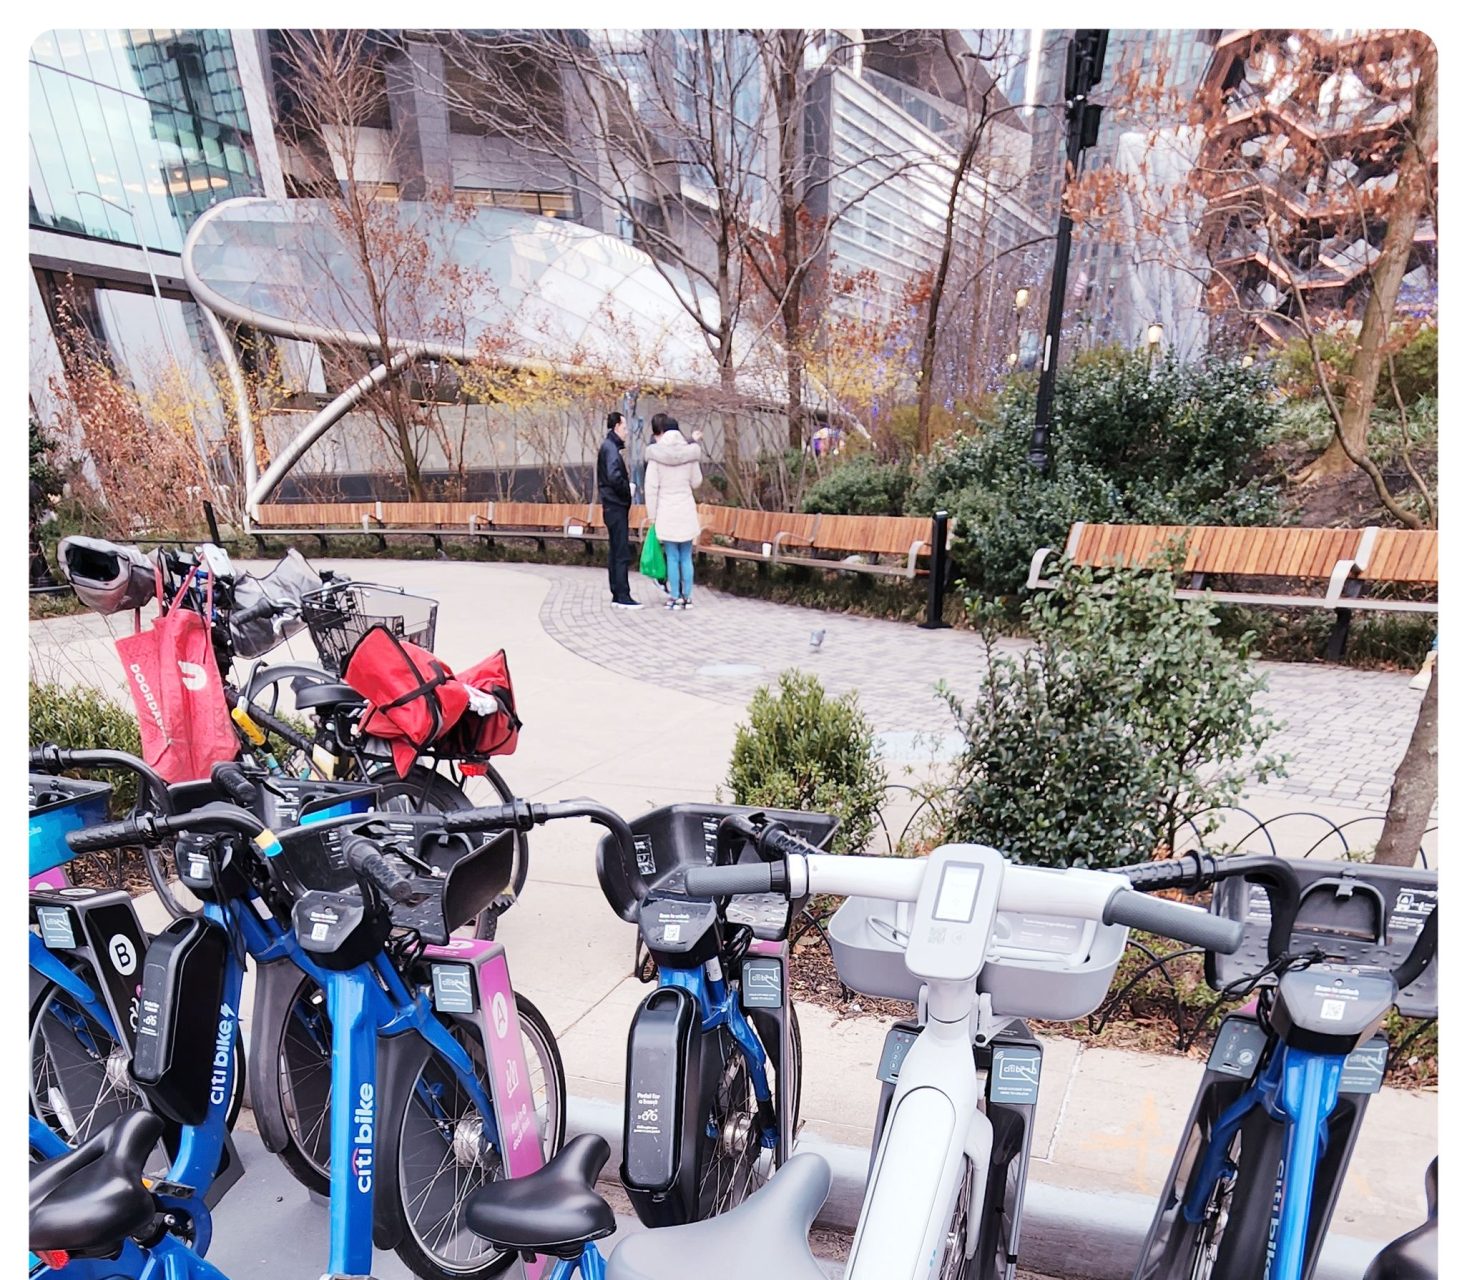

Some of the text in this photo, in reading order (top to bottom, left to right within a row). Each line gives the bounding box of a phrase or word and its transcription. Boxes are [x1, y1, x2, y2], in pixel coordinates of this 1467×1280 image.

[130, 663, 168, 738] DOORDA
[114, 942, 131, 968] B
[210, 1019, 233, 1105] citi bike
[352, 1082, 374, 1194] citi bike
